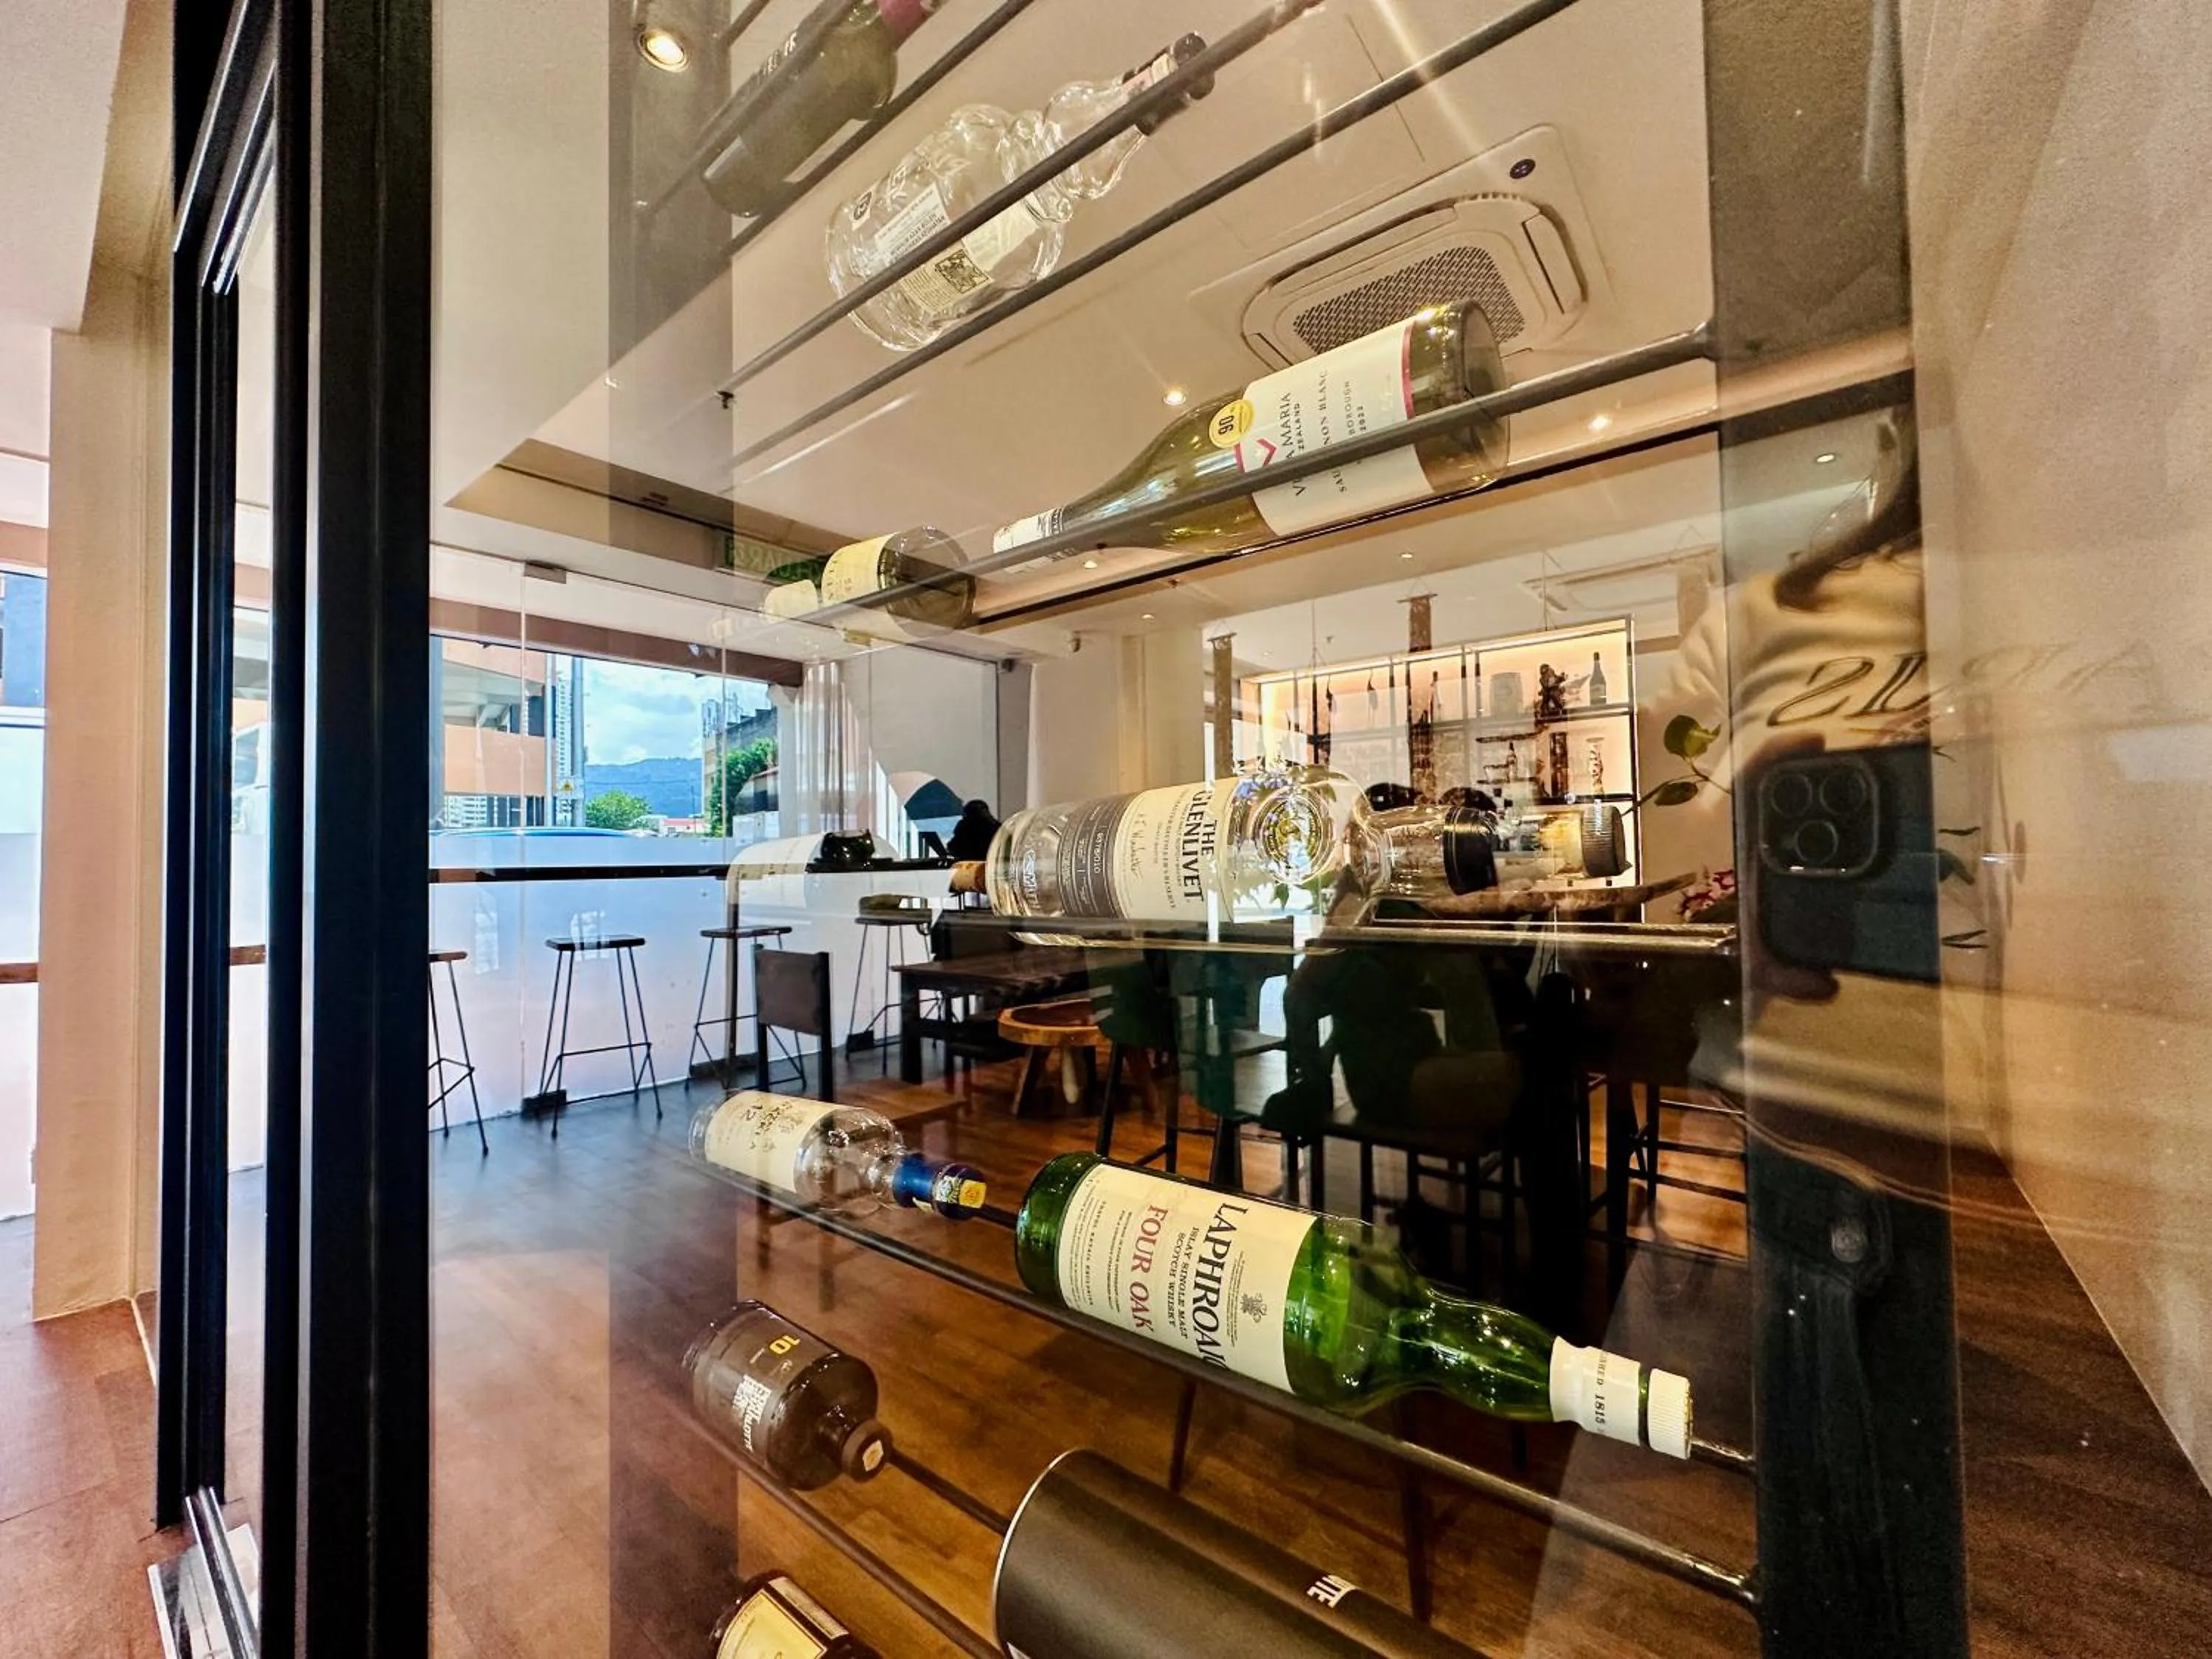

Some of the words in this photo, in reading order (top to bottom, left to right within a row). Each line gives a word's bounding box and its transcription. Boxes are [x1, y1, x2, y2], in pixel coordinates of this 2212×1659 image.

[1217, 414, 1235, 436] 90
[1279, 392, 1294, 447] MARIA
[1181, 790, 1214, 902] GLENLIVET
[1201, 819, 1217, 857] THE
[1130, 1204, 1169, 1275] FOUR
[1169, 1232, 1186, 1278] SCOTCH
[1183, 1226, 1200, 1260] ISLAY
[1178, 1262, 1189, 1307] SINGLE
[1130, 1281, 1154, 1334] OAK
[1178, 1308, 1189, 1340] MALT
[769, 1335, 800, 1354] 10
[1595, 1394, 1606, 1425] 1815
